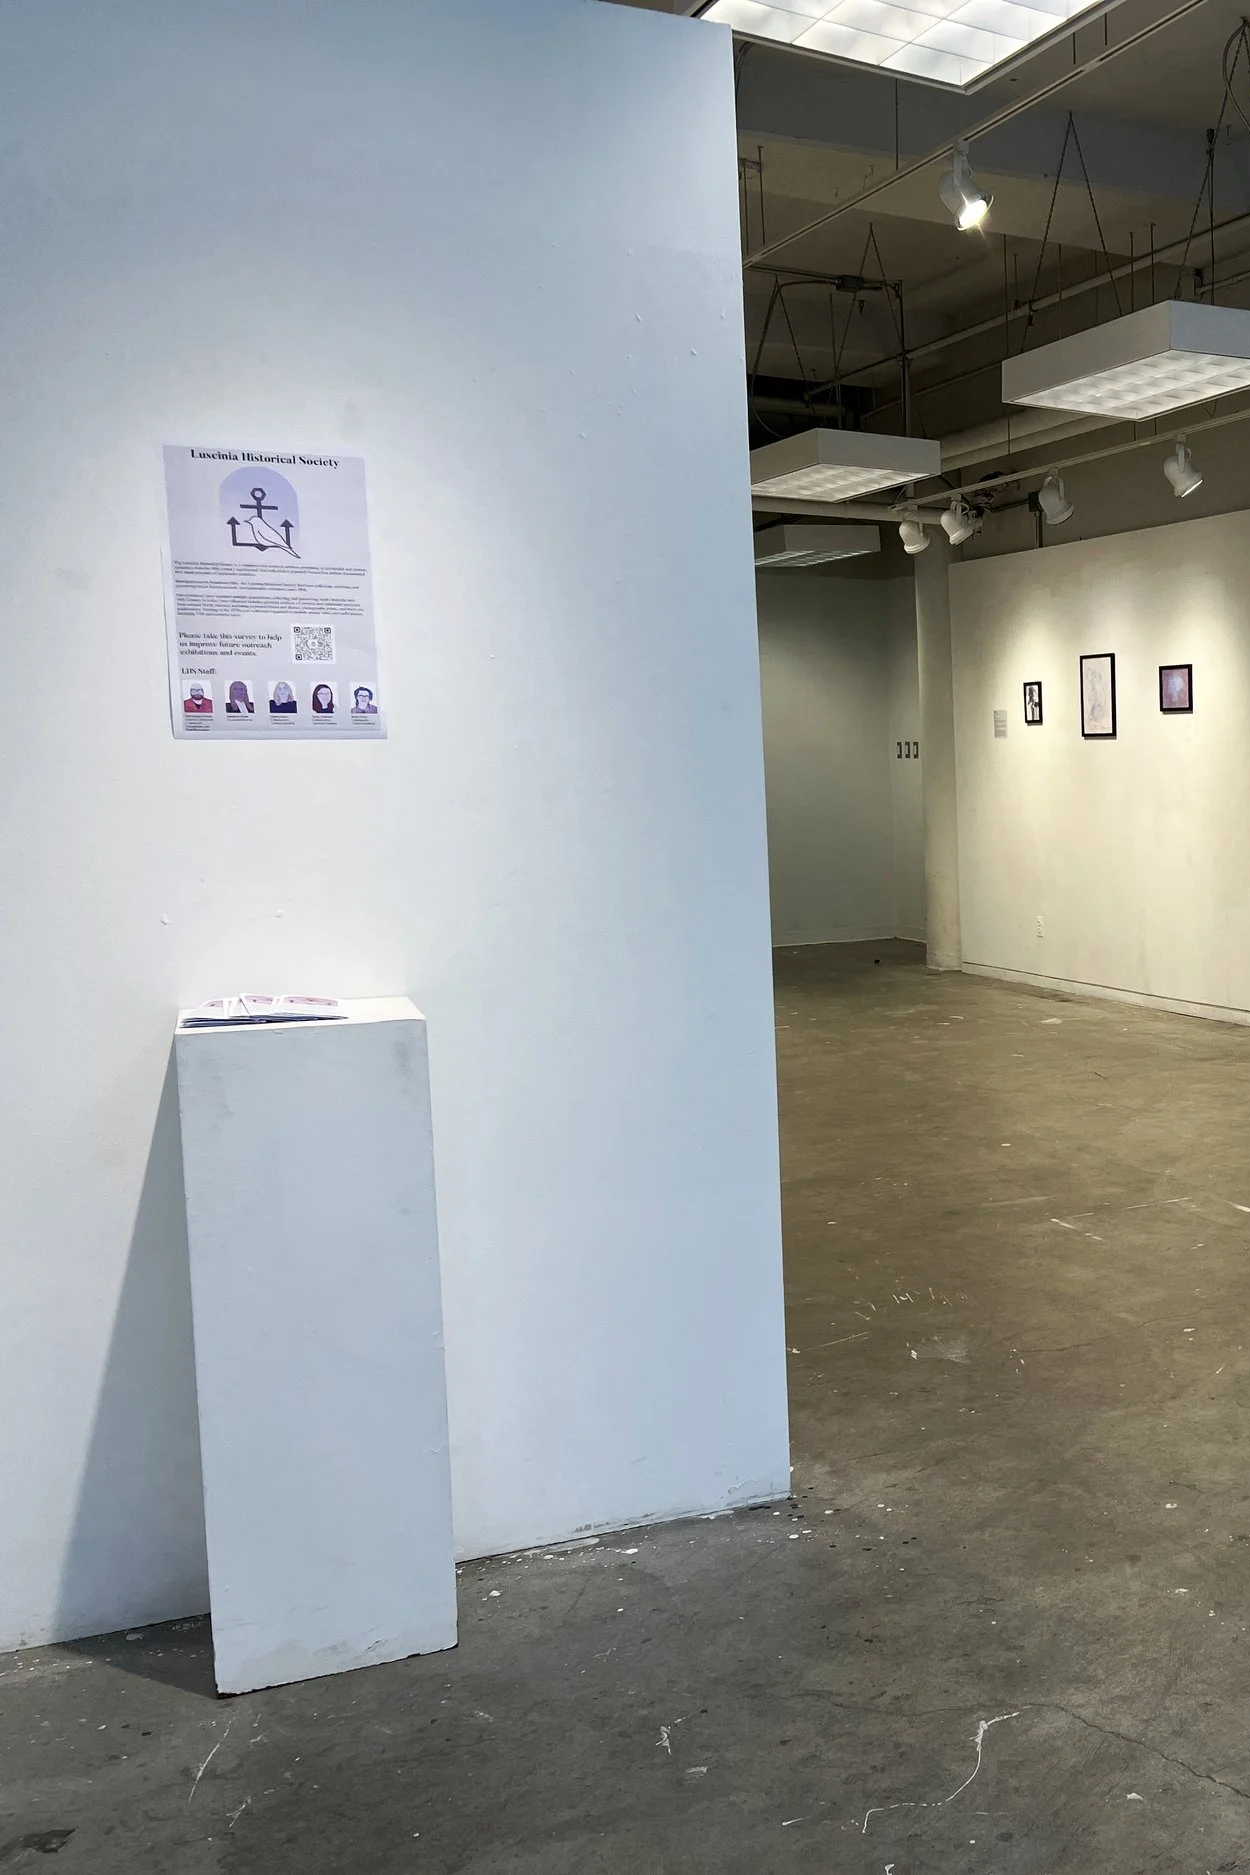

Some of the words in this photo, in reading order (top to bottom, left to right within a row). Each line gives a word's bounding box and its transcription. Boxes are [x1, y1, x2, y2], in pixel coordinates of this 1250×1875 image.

[190, 448, 239, 461] Luscinia
[241, 452, 296, 465] Historical
[298, 455, 339, 469] Society
[268, 634, 283, 642] help
